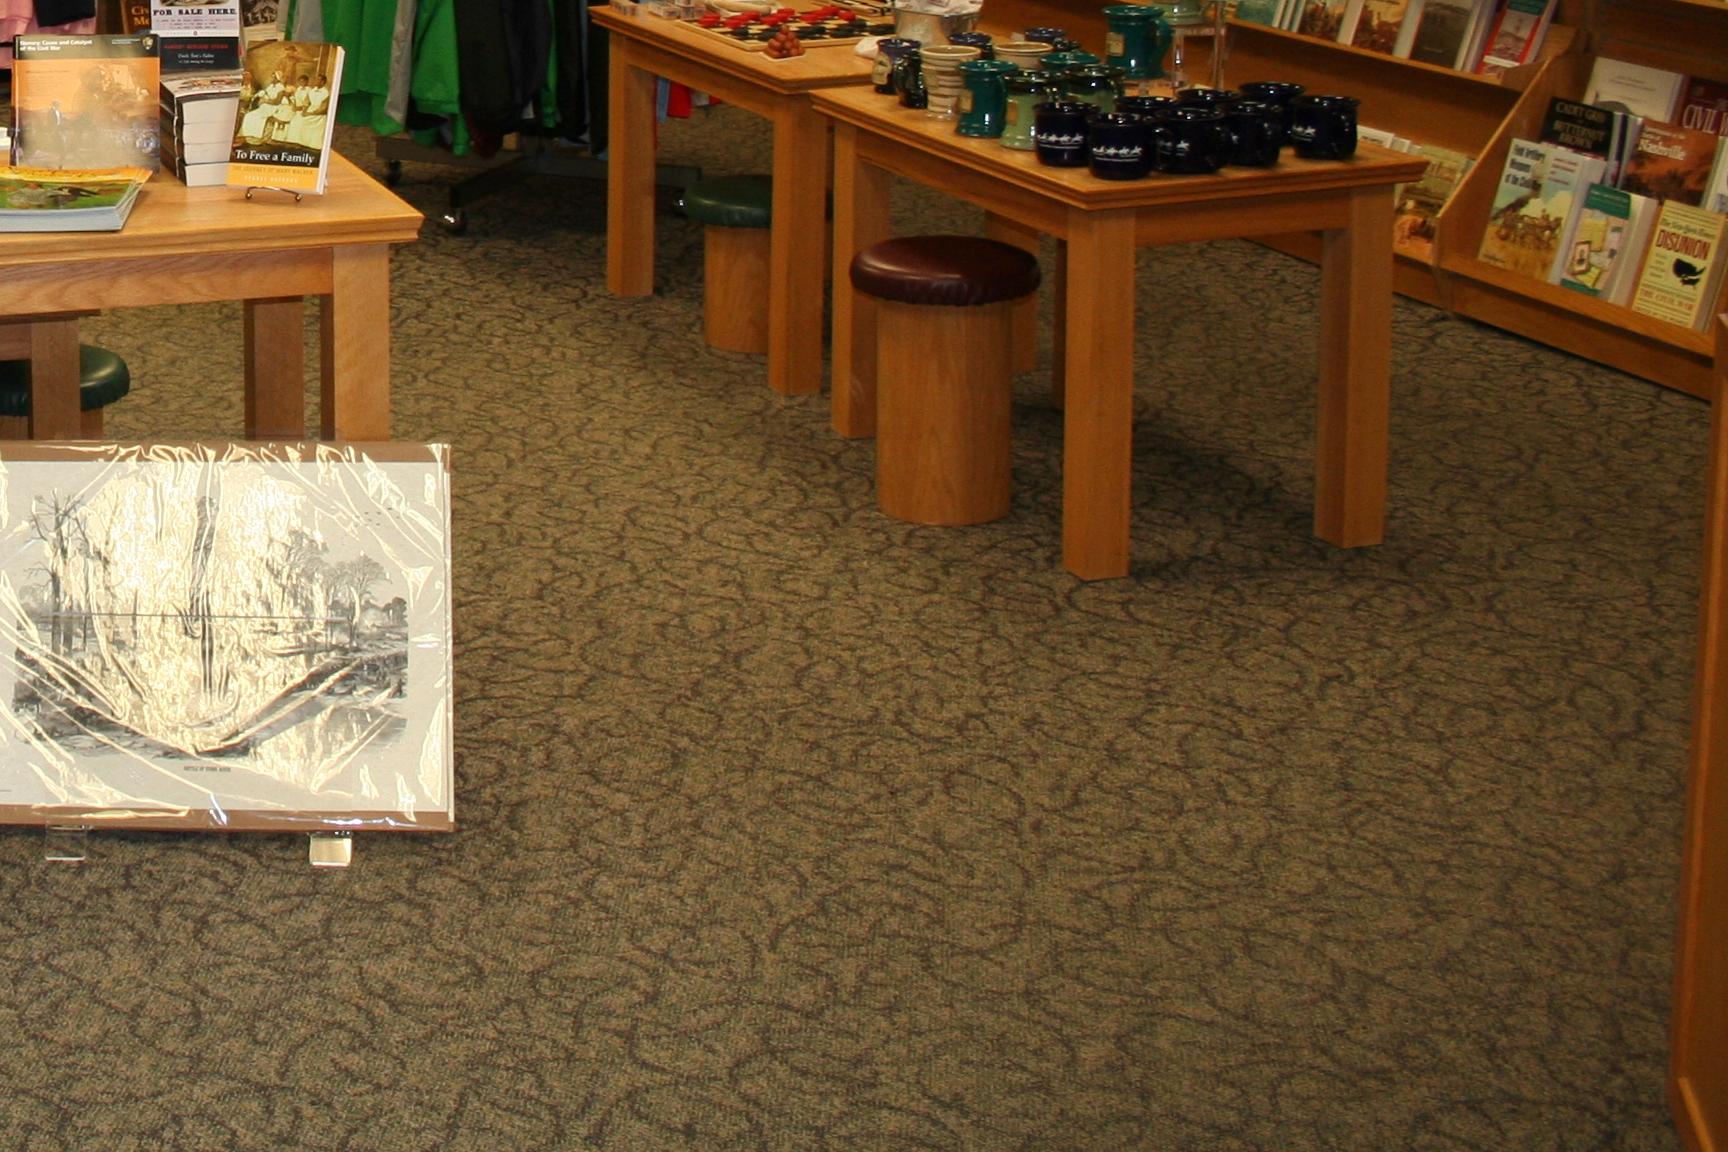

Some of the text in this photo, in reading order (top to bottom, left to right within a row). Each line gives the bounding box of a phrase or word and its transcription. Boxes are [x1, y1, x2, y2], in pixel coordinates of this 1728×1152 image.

[1683, 104, 1719, 135] CIVIL
[236, 150, 247, 159] To
[249, 150, 270, 160] Free
[281, 152, 314, 165] Family
[1638, 138, 1686, 160] Nashville
[1656, 230, 1711, 261] DISUNION
